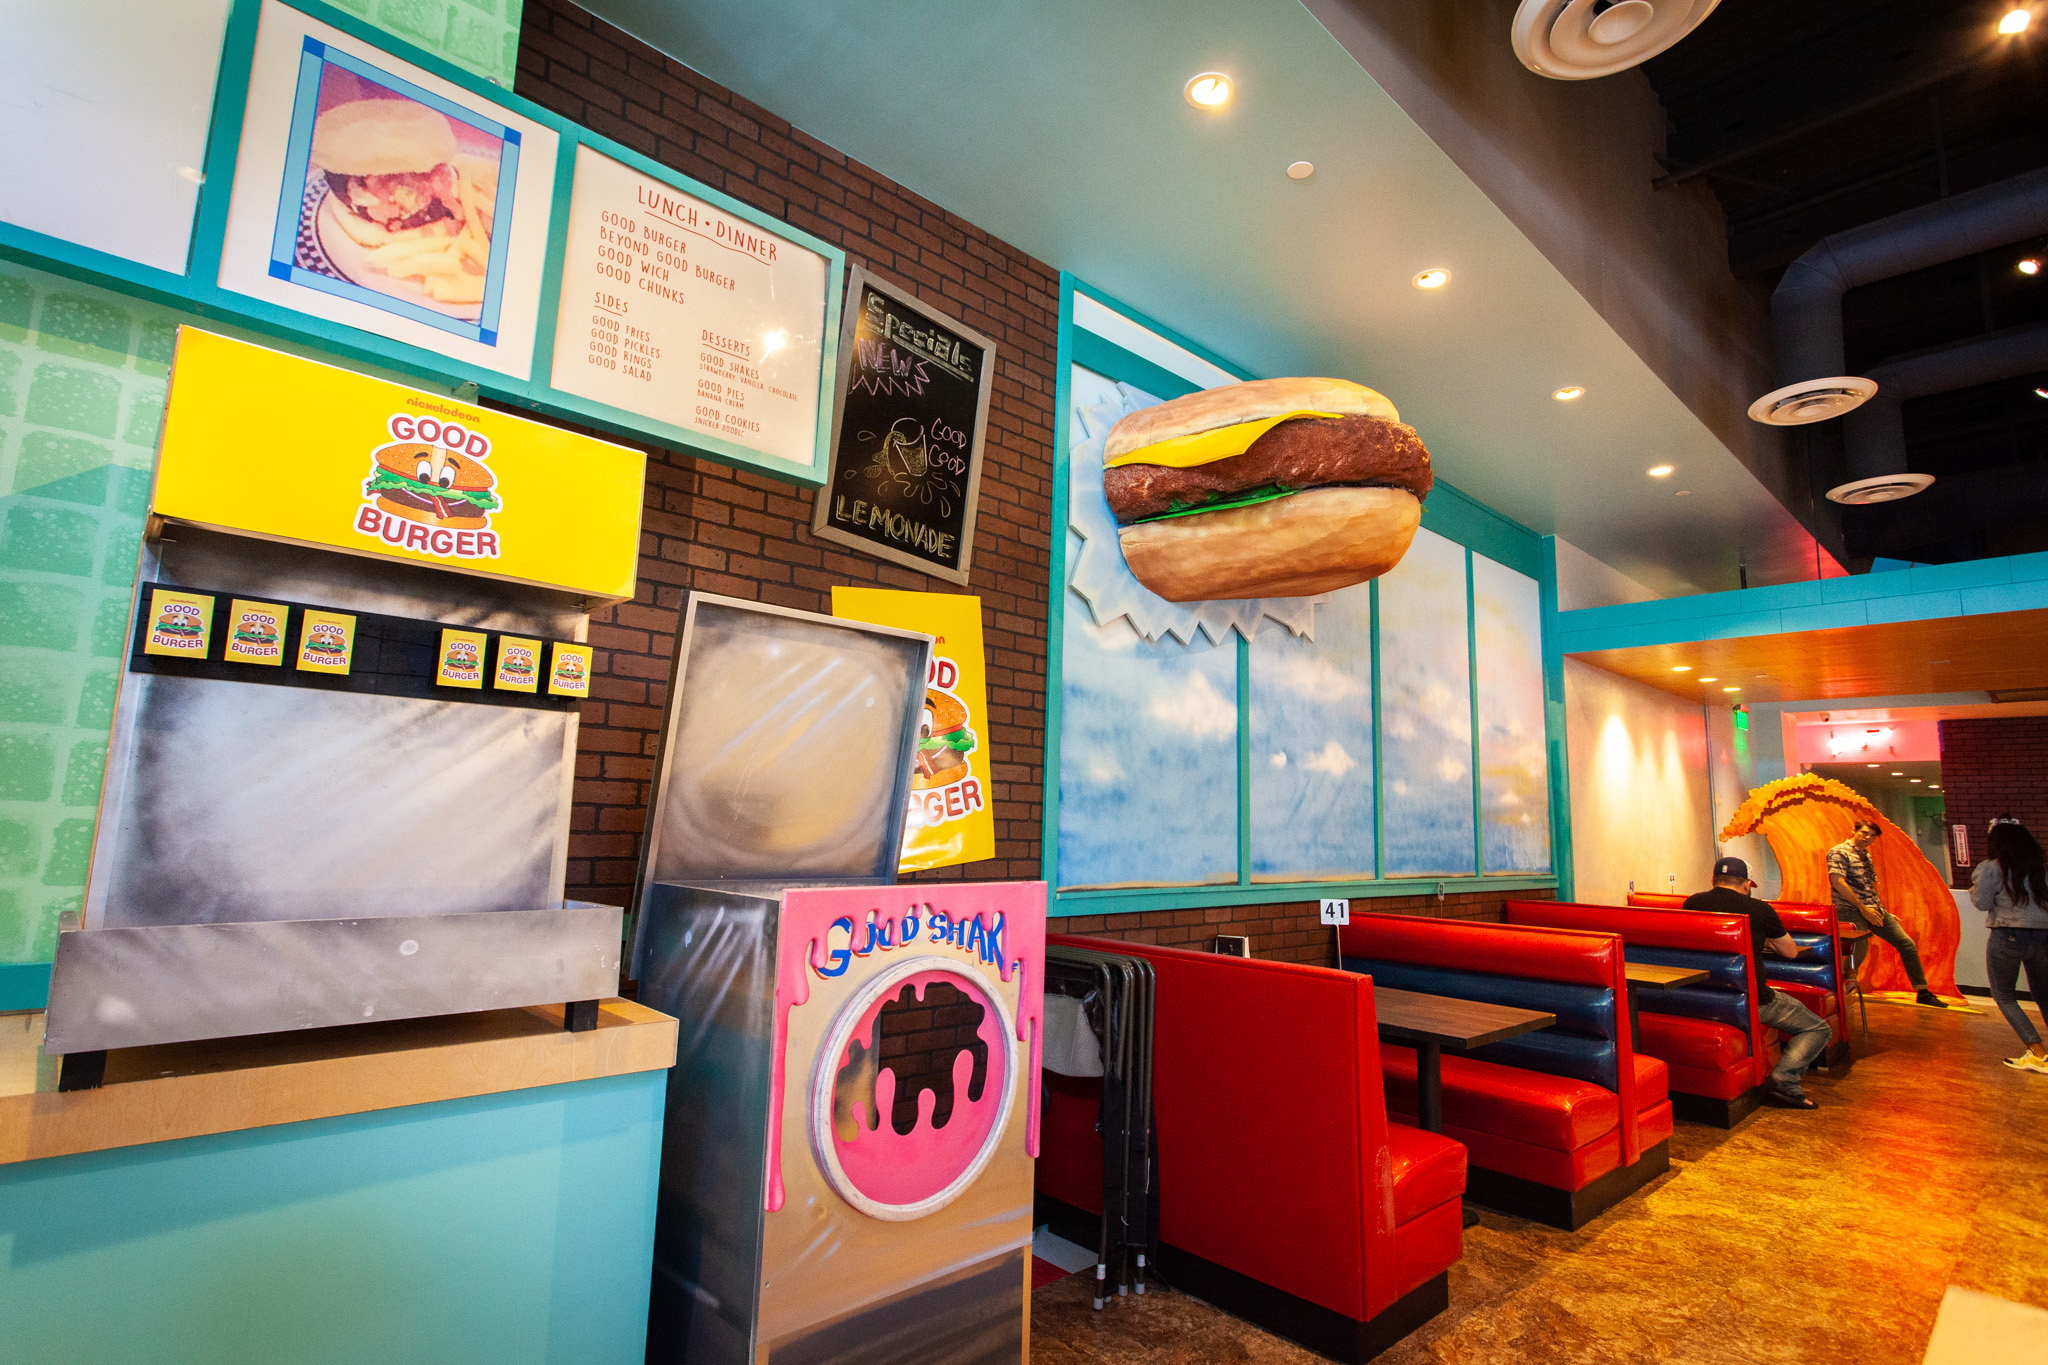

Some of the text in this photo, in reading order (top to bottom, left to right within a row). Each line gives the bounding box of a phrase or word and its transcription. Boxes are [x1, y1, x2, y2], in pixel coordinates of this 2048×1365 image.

[601, 210, 687, 254] GOOD BURGER
[638, 185, 777, 261] LUNCH DINNER
[598, 245, 670, 282] GOOD WICH
[600, 226, 736, 291] BEYOND GOOD BURGER
[596, 262, 685, 305] GOOD CHUNKS
[594, 292, 629, 313] SIDES
[592, 315, 650, 342] GOOD FRIES
[589, 341, 652, 369] GOOD RINGS
[591, 328, 661, 359] GOOD PICKLES
[702, 329, 751, 357] DESSERTS
[588, 354, 652, 382] GOOD SALAD
[700, 352, 760, 380] GOOD SHAKES
[858, 337, 913, 377] NEW
[697, 389, 744, 410] BANANA CREAM
[698, 379, 745, 401] GOOD PIES
[768, 386, 798, 401] CHOCOLATE
[406, 397, 481, 424] nickelodeon
[695, 405, 760, 433] GOOD COOKIES
[391, 416, 489, 458] GOOD
[357, 506, 498, 556] BURGER
[836, 494, 956, 559] LEMONADE
[164, 604, 200, 616] GOOD
[242, 614, 275, 625] GOOD
[152, 634, 204, 648] BURGER
[313, 624, 344, 636] GOOD
[231, 642, 279, 656] BURGER
[302, 652, 347, 665] BURGER
[450, 642, 477, 653] GOOD
[507, 648, 532, 658] GOOD
[560, 654, 584, 664] GOOD
[442, 668, 480, 680] BURGER
[499, 672, 535, 684] BURGER
[553, 678, 586, 690] BURGER
[906, 779, 982, 823] GER
[1325, 902, 1345, 919] 41
[926, 912, 1019, 974] SHAK
